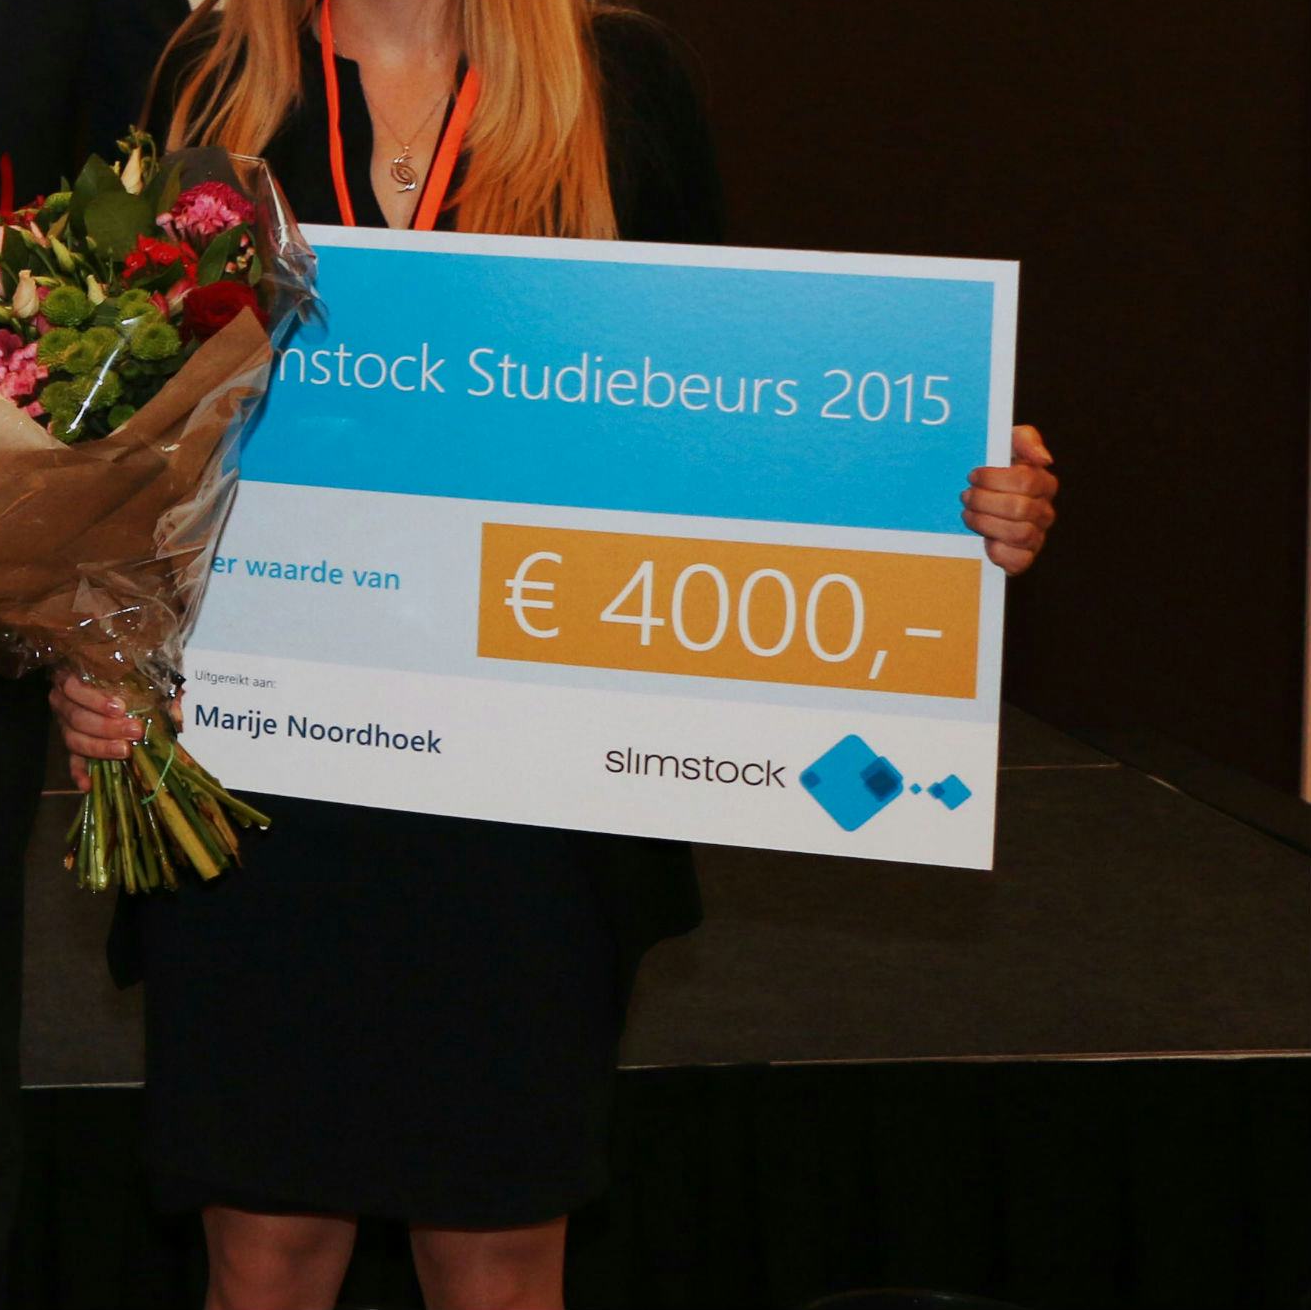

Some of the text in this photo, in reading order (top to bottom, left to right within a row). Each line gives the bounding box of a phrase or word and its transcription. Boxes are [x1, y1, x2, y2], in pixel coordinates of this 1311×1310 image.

[467, 347, 798, 417] Studiebeurs
[820, 369, 951, 426] 2015
[211, 556, 400, 590] er waarde van
[504, 551, 942, 680] € 4000,-
[195, 670, 248, 686] Uitgereikt
[195, 704, 442, 753] Marije Noordhoek
[605, 747, 786, 788] slimstock
